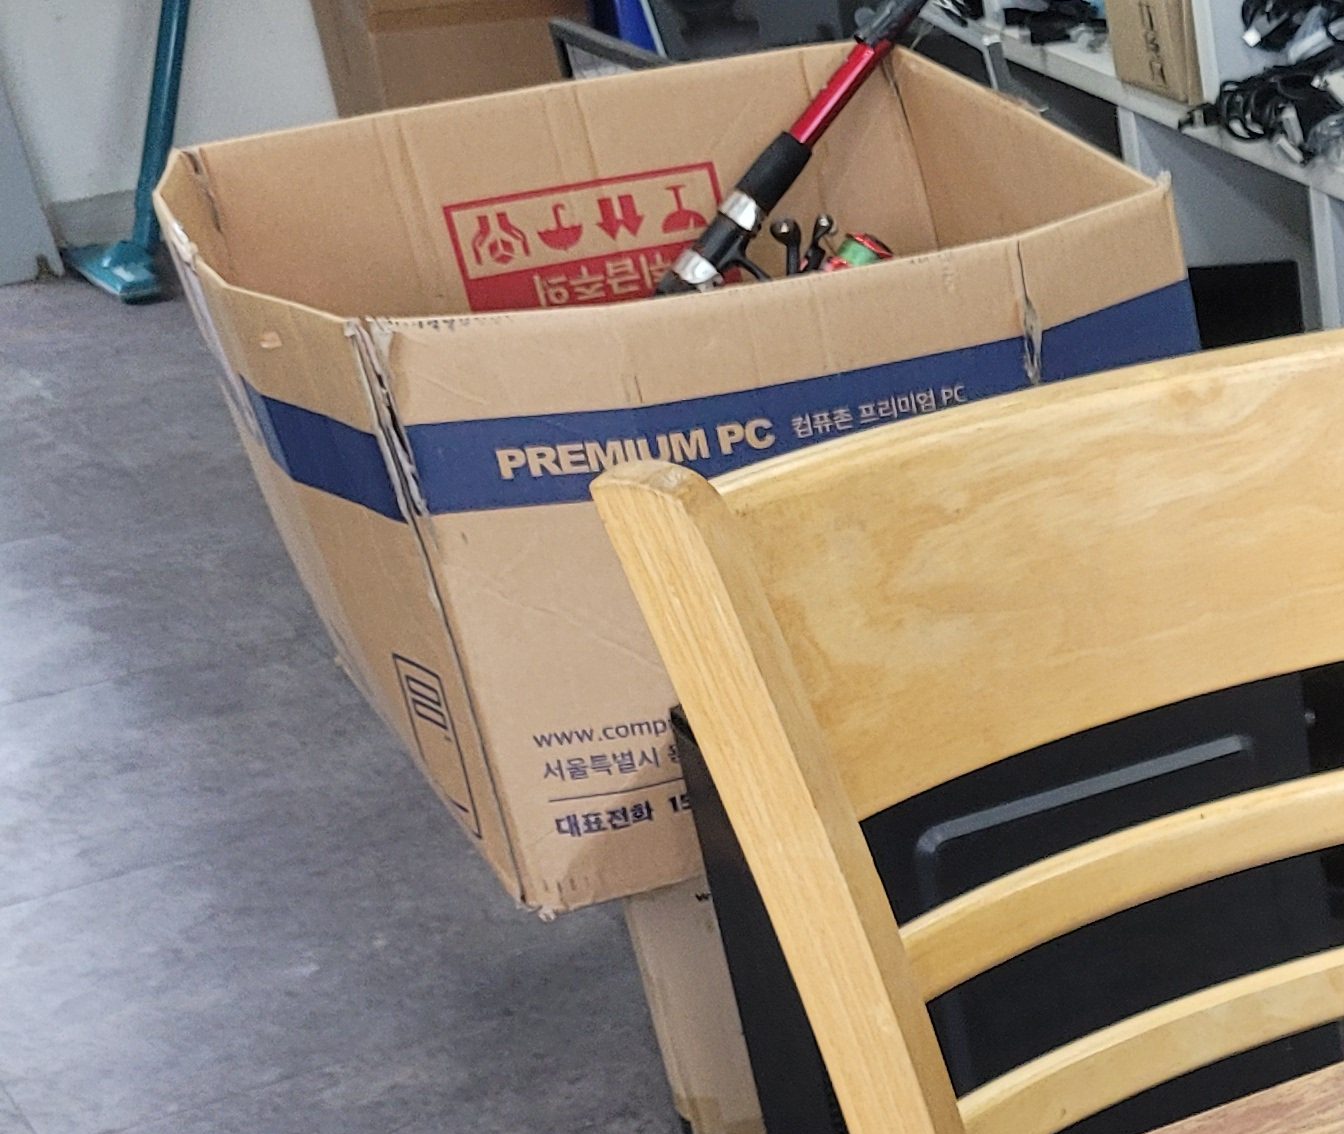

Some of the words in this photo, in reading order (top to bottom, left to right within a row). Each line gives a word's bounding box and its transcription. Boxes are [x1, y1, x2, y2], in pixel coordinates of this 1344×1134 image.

[857, 391, 935, 426] 프리미엄
[941, 384, 967, 407] PC
[496, 426, 709, 480] PREMIUM
[716, 417, 777, 456] PC
[543, 745, 661, 783] 서울특별시
[554, 800, 656, 838] 대표전화
